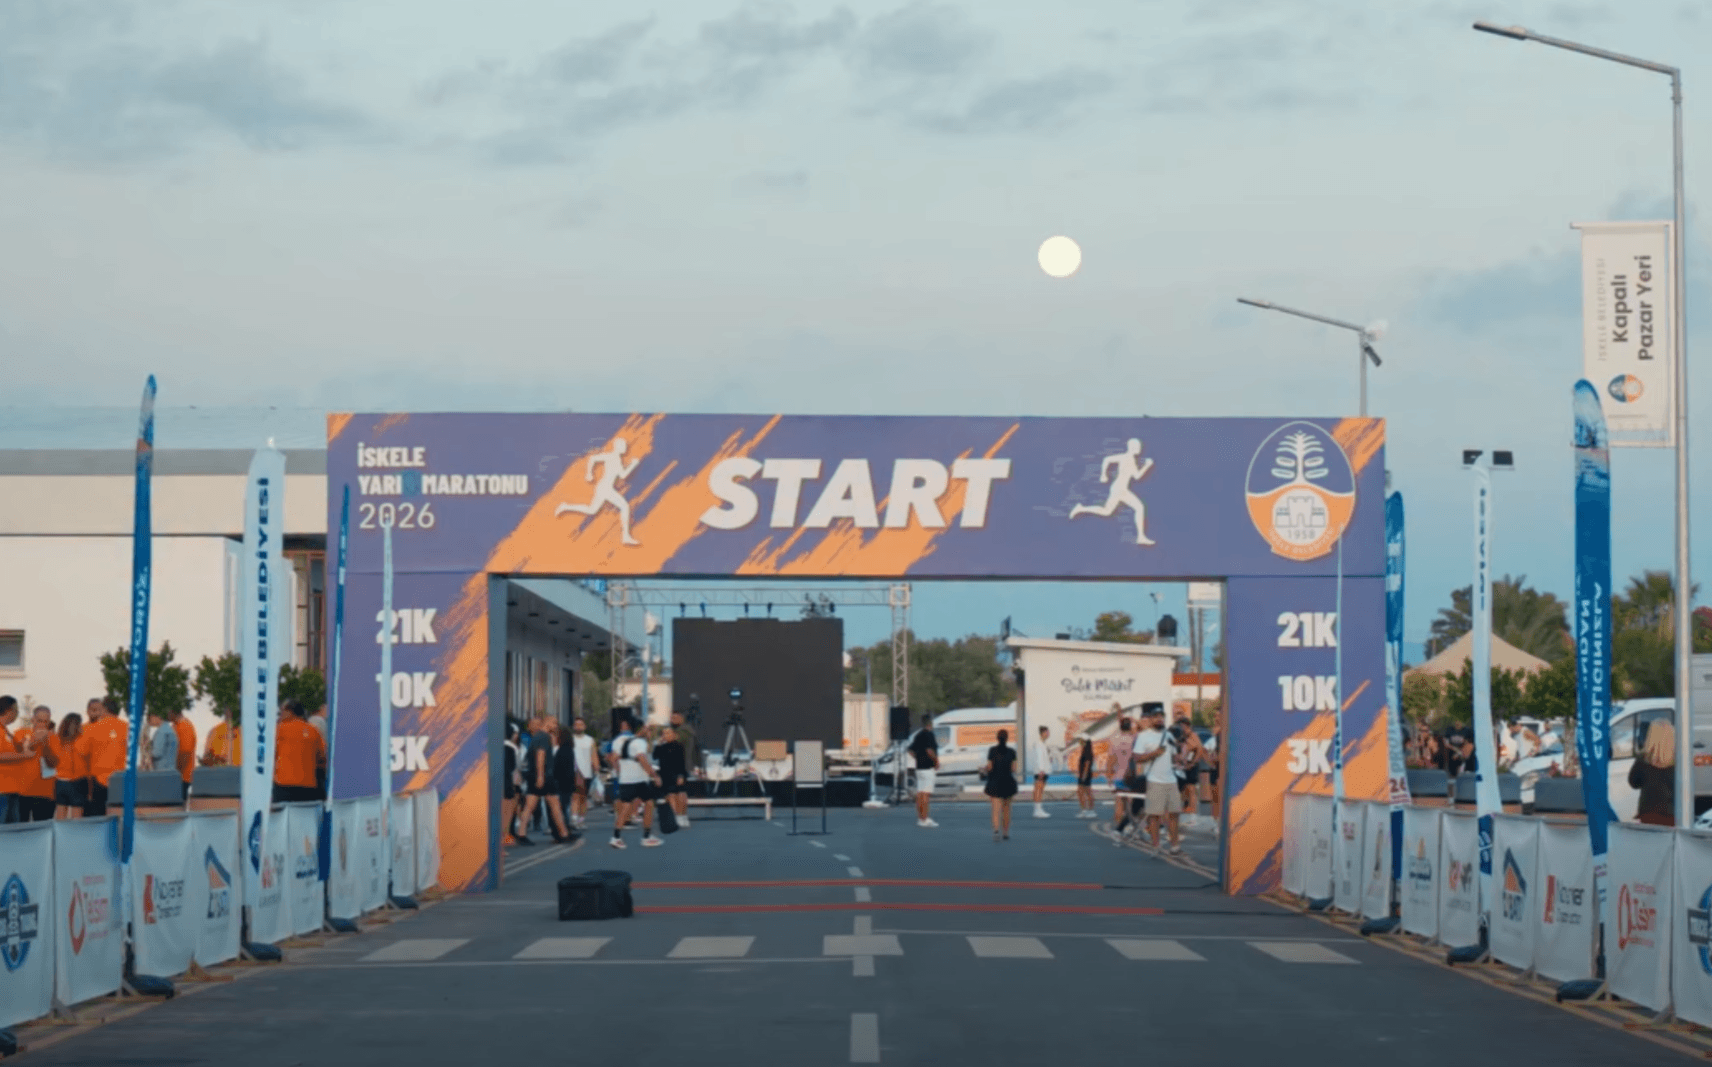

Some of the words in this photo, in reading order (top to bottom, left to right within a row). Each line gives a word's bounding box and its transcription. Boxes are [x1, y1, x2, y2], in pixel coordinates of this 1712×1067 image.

[1633, 254, 1652, 297] Yeri
[1610, 273, 1633, 343] Kapalı
[1637, 300, 1653, 361] Pazar
[357, 442, 426, 468] İSKELE
[357, 474, 410, 496] YARI
[421, 474, 528, 496] MARATONU
[698, 456, 1013, 531] START
[358, 502, 436, 529] 2026
[255, 477, 269, 660] BELEDİYESİ
[375, 608, 438, 644] 21K
[1276, 611, 1338, 648] 21K
[375, 671, 438, 708] 0K
[1277, 674, 1338, 711] 10K
[255, 666, 267, 775] İSKELE
[1286, 738, 1333, 774] 3K
